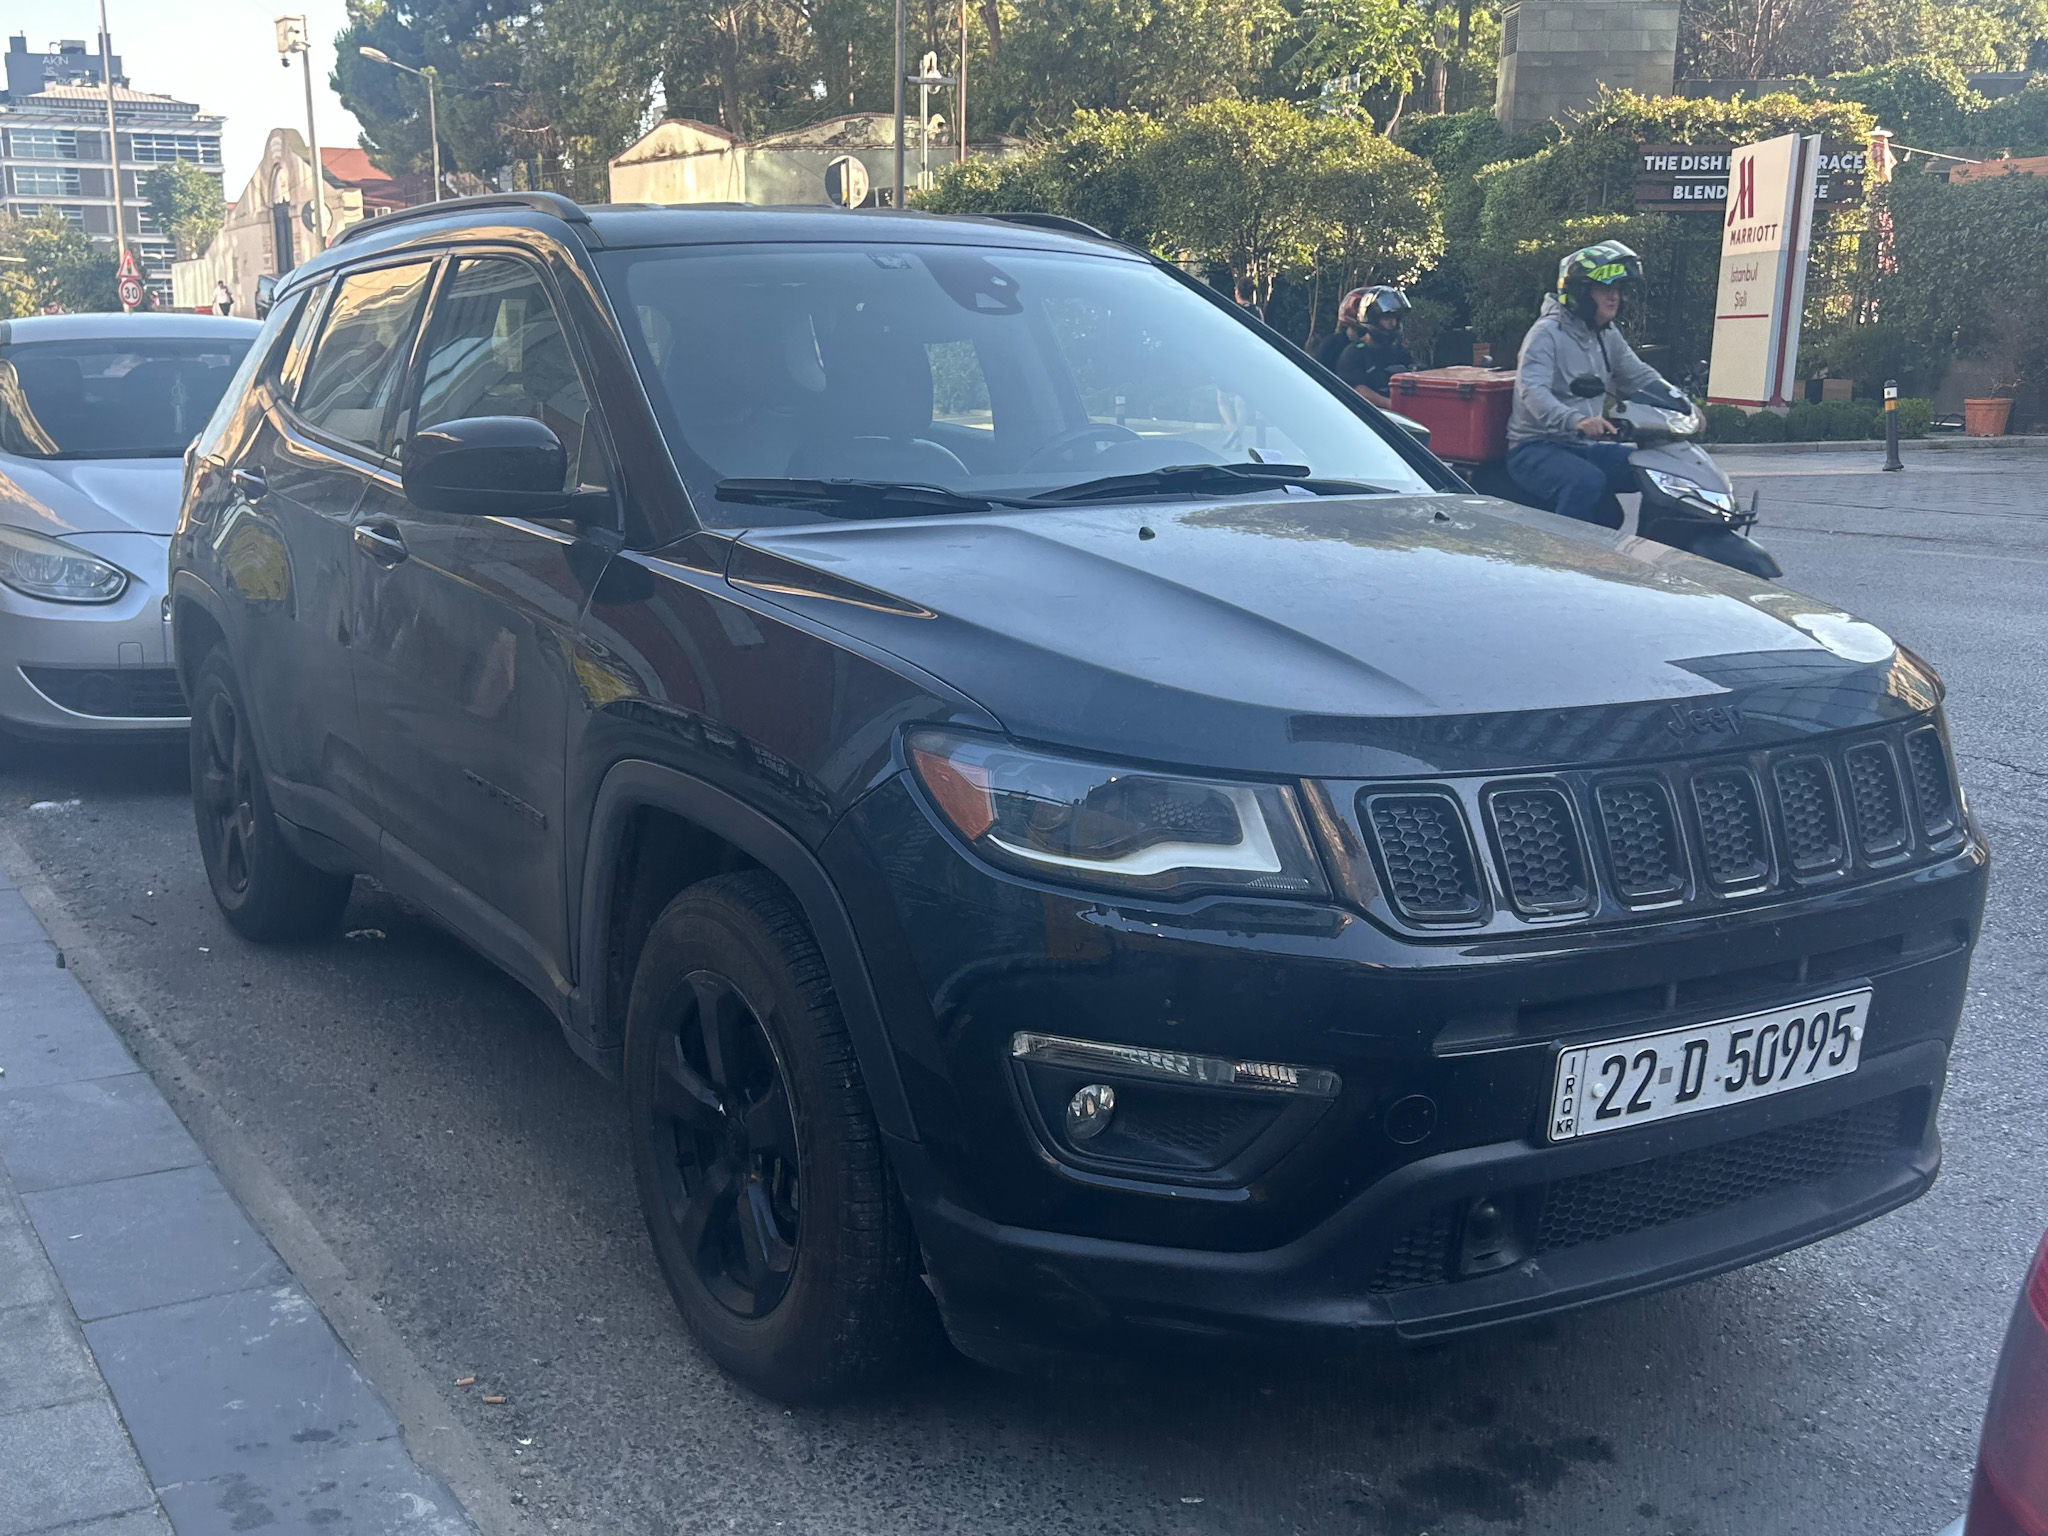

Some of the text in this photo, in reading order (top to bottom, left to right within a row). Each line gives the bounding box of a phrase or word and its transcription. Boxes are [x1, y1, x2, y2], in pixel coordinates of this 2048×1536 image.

[1644, 155, 1678, 171] THE
[1681, 155, 1723, 171] DISH
[1817, 154, 1864, 170] RACE
[1730, 224, 1778, 246] MARRIOTT
[124, 286, 138, 300] 30
[1666, 703, 1742, 736] Jeep
[1595, 1004, 1857, 1121] 22 D 50995
